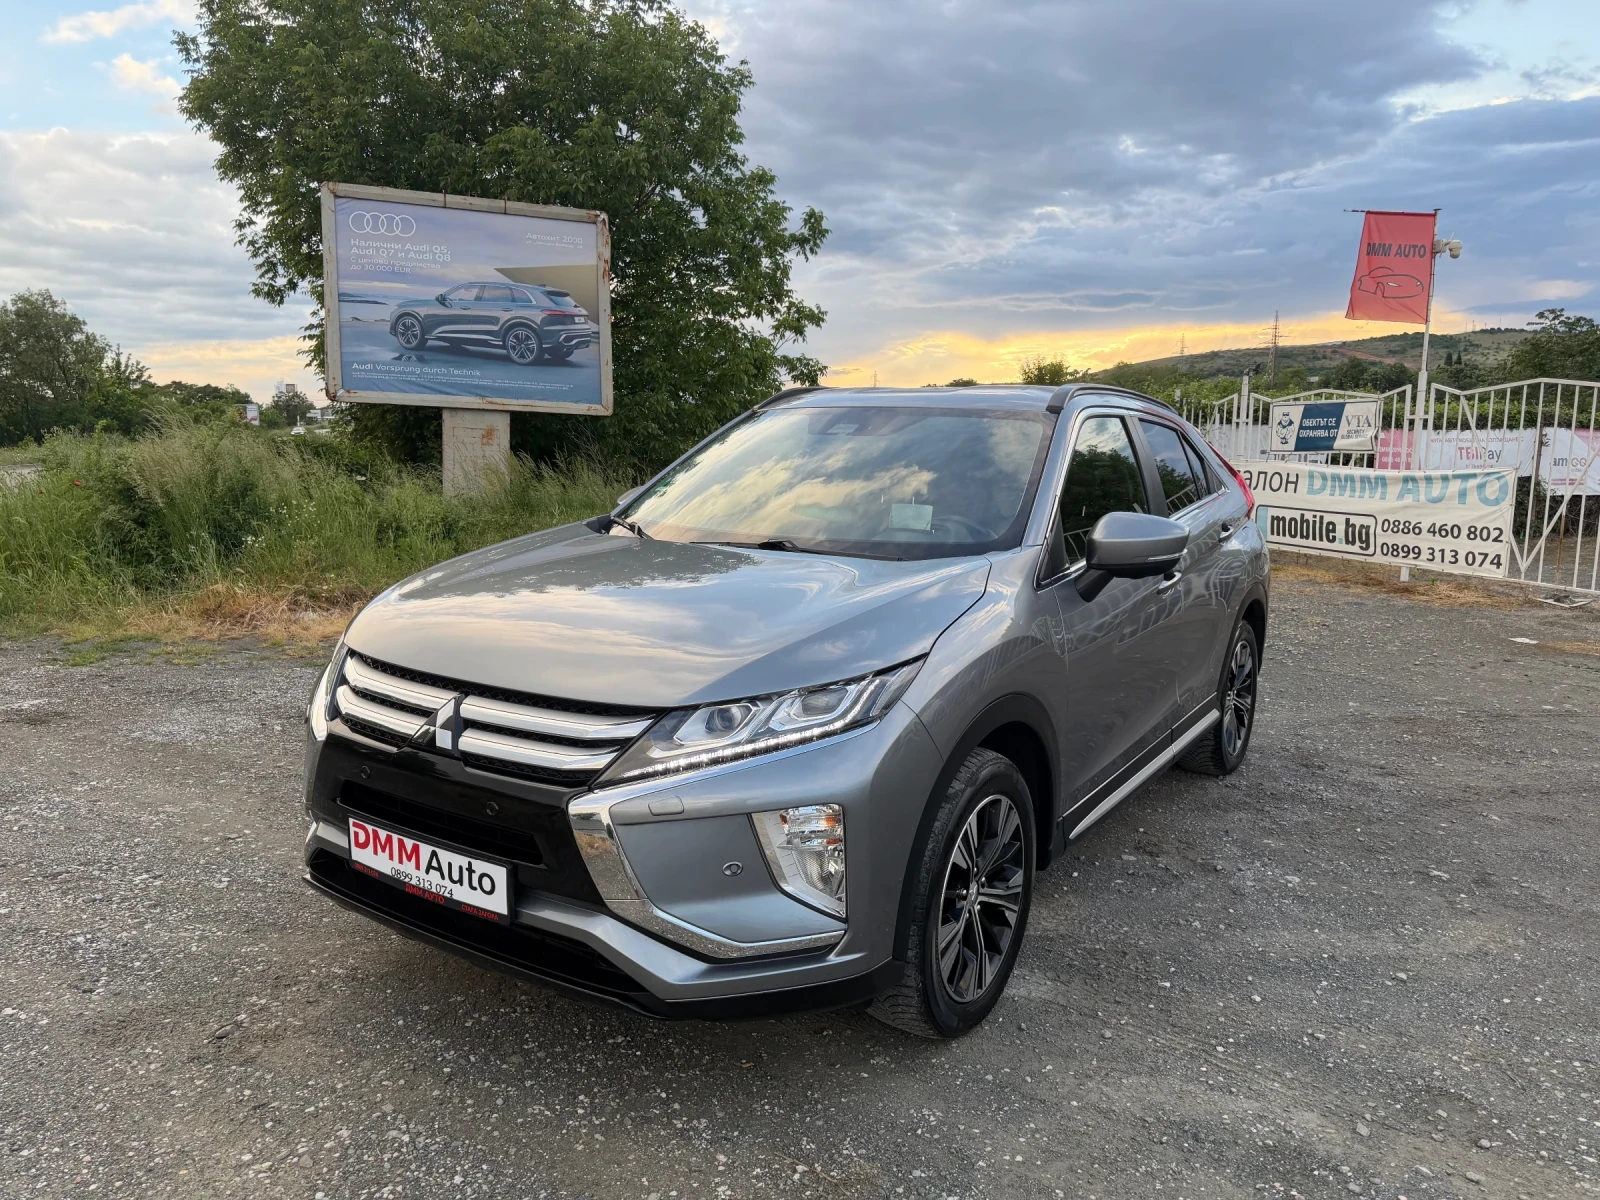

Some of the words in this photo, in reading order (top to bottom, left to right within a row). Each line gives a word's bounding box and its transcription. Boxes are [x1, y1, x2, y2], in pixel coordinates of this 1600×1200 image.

[526, 232, 560, 241] Автохит
[562, 235, 583, 244] 2000
[350, 238, 402, 249] Налични
[405, 242, 429, 252] Audi
[432, 245, 451, 254] Q5,
[1366, 242, 1392, 257] DMM
[1394, 243, 1427, 258] AUTO
[350, 247, 376, 255] Audi
[380, 248, 395, 258] Q7
[408, 252, 433, 260] Audi
[436, 253, 451, 262] Q8
[358, 257, 389, 265] ценово
[390, 260, 441, 269] предимство
[394, 266, 411, 274] EUR
[352, 362, 373, 370] Audi
[375, 364, 421, 373] Vorsprung
[423, 366, 447, 374] durch
[449, 367, 481, 376] Technik
[1302, 418, 1327, 427] ОБЕКТЪТ
[1328, 417, 1337, 426] СЕ
[1345, 414, 1372, 428] VTA
[1299, 429, 1329, 438] ОХРАНЯВА
[1330, 428, 1338, 437] ОТ
[1236, 469, 1299, 494] алон
[1306, 469, 1388, 501] DMM
[1396, 471, 1509, 507] AUTO
[1270, 513, 1371, 551] mobile.bg
[1381, 518, 1422, 536] 0886
[1427, 522, 1462, 539] 460
[1466, 525, 1504, 543] 802
[1380, 542, 1422, 560] 0899
[1426, 547, 1459, 565] 313
[1464, 551, 1503, 570] 074
[390, 866, 413, 883] 0899
[415, 875, 433, 891] 313
[435, 883, 454, 898] 074
[405, 883, 423, 897] ДММ
[425, 893, 445, 905] АУТО
